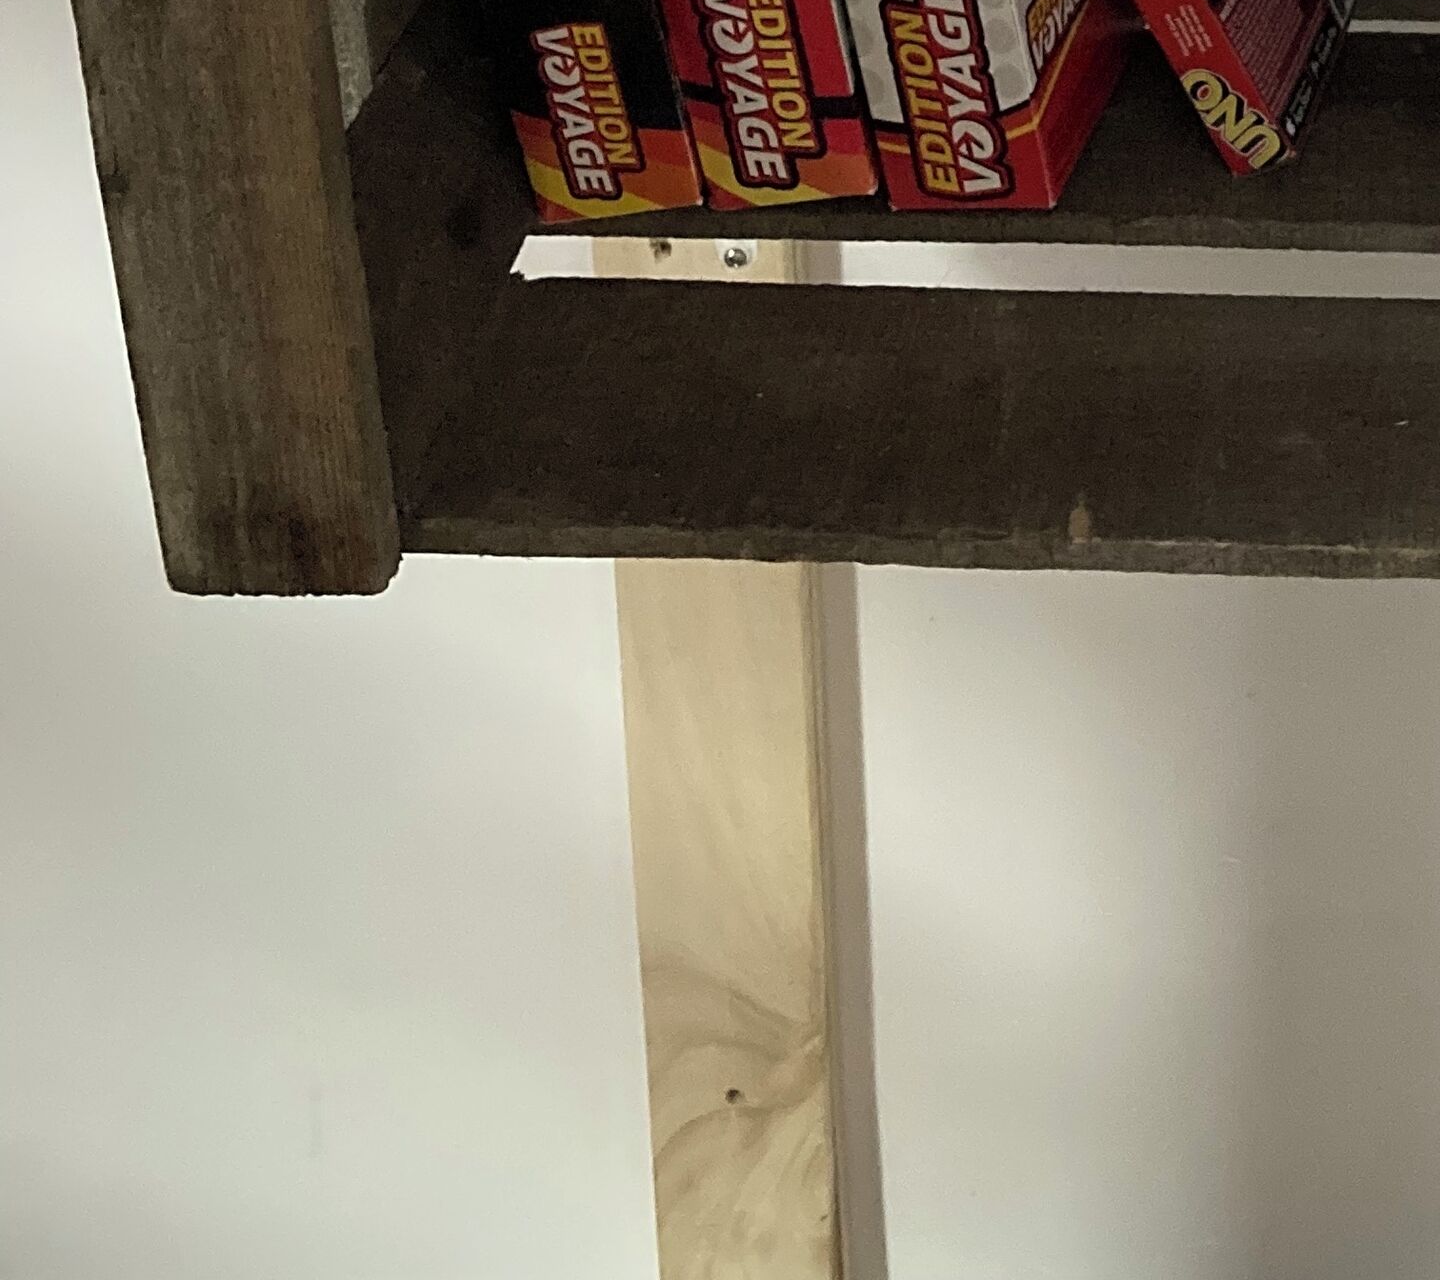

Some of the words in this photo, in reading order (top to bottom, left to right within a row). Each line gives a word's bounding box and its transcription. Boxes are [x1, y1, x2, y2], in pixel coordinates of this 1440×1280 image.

[534, 27, 614, 194] VOYAGE
[571, 24, 639, 166] EDITION
[890, 9, 961, 193] EDITION
[1180, 68, 1287, 171] UNO
